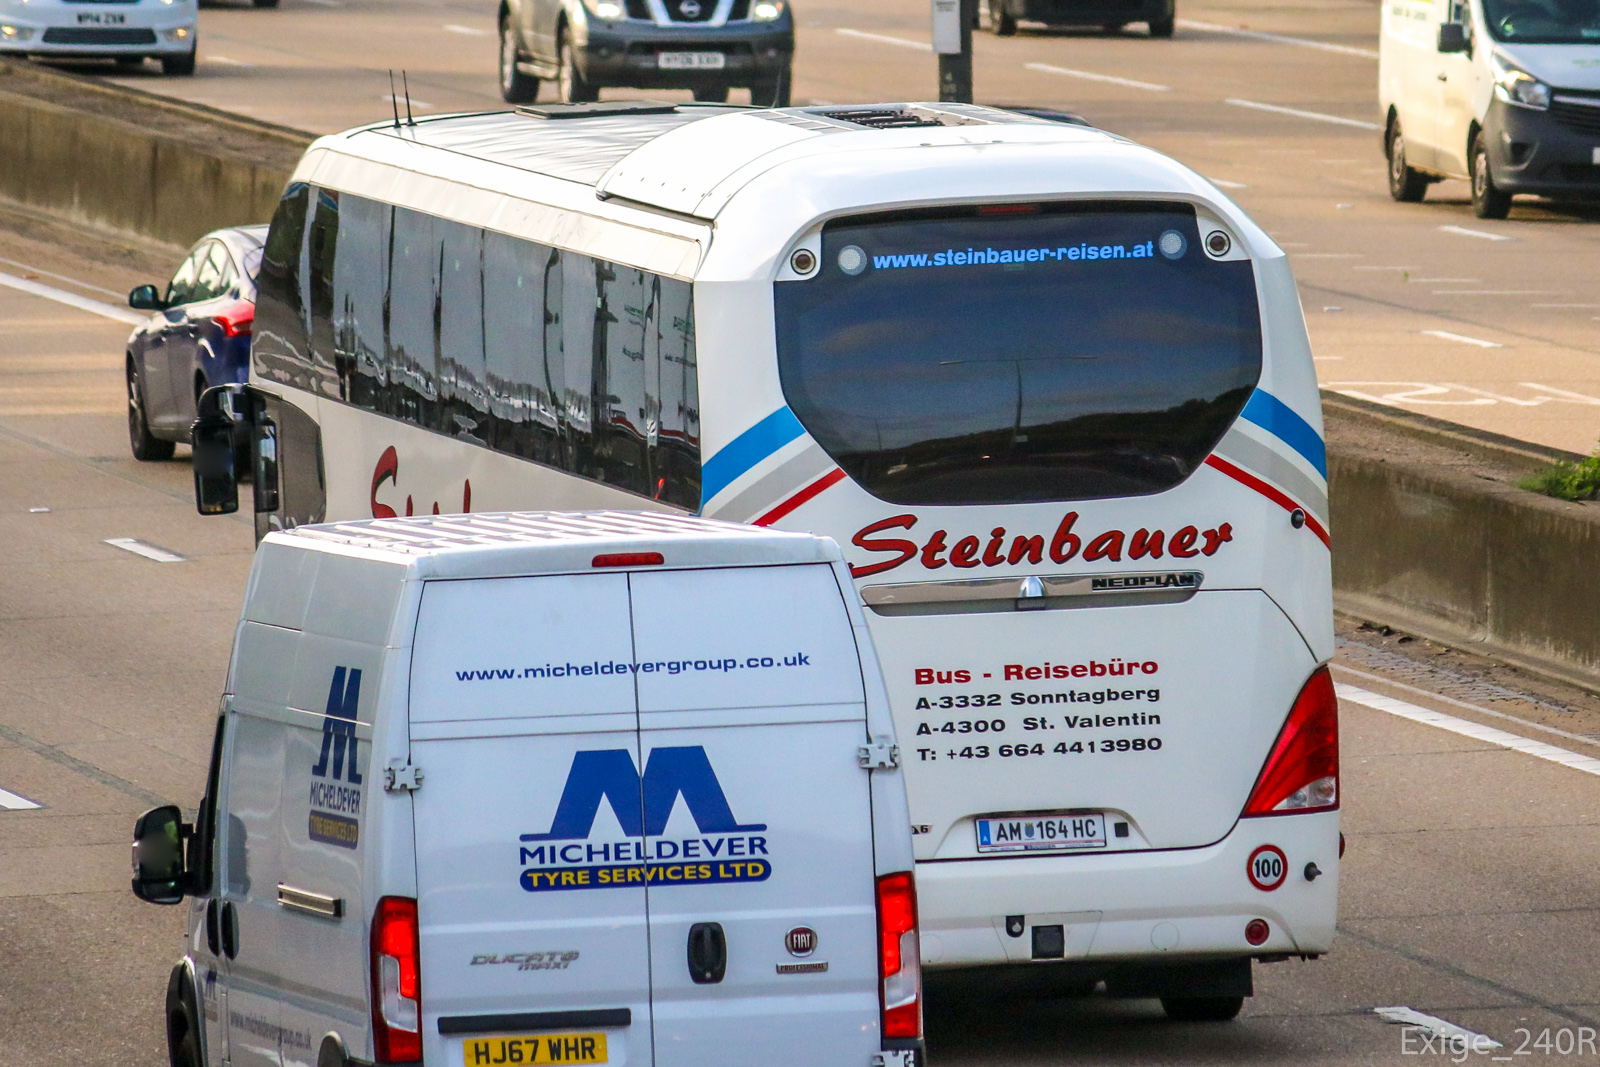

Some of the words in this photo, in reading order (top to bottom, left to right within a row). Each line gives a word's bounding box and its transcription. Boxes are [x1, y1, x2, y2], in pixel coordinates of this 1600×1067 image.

[873, 241, 1154, 270] www.steinbauer-reisen.at
[848, 511, 1233, 579] Steinbauer
[1091, 573, 1195, 589] NEOPLAN
[455, 652, 810, 681] www.micheldevergroup.co.uk
[915, 668, 971, 685] Bus
[1004, 658, 1159, 681] Reisebüro
[915, 694, 1001, 710] A-3332
[1010, 688, 1161, 706] Sonntagberg
[916, 719, 1006, 735] A-4300
[1023, 717, 1055, 731] St.
[1064, 712, 1162, 729] Valentin
[917, 748, 937, 761] T:
[947, 745, 990, 759] +43
[999, 743, 1045, 757] 664
[1053, 737, 1162, 755] 4413980
[310, 781, 361, 815] MICHELDEVER
[996, 821, 1022, 841] AM
[1036, 820, 1068, 839] 164
[1072, 819, 1096, 838] HC
[519, 836, 769, 866] MICHELDEVER
[527, 867, 590, 888] TYRE
[598, 864, 711, 883] SERVICES
[719, 862, 765, 878] LTD
[1254, 858, 1281, 878] 100
[792, 933, 811, 949] FIAT
[469, 950, 580, 966] DUCATO
[474, 1039, 539, 1065] HJ67
[548, 1037, 596, 1061] WHR
